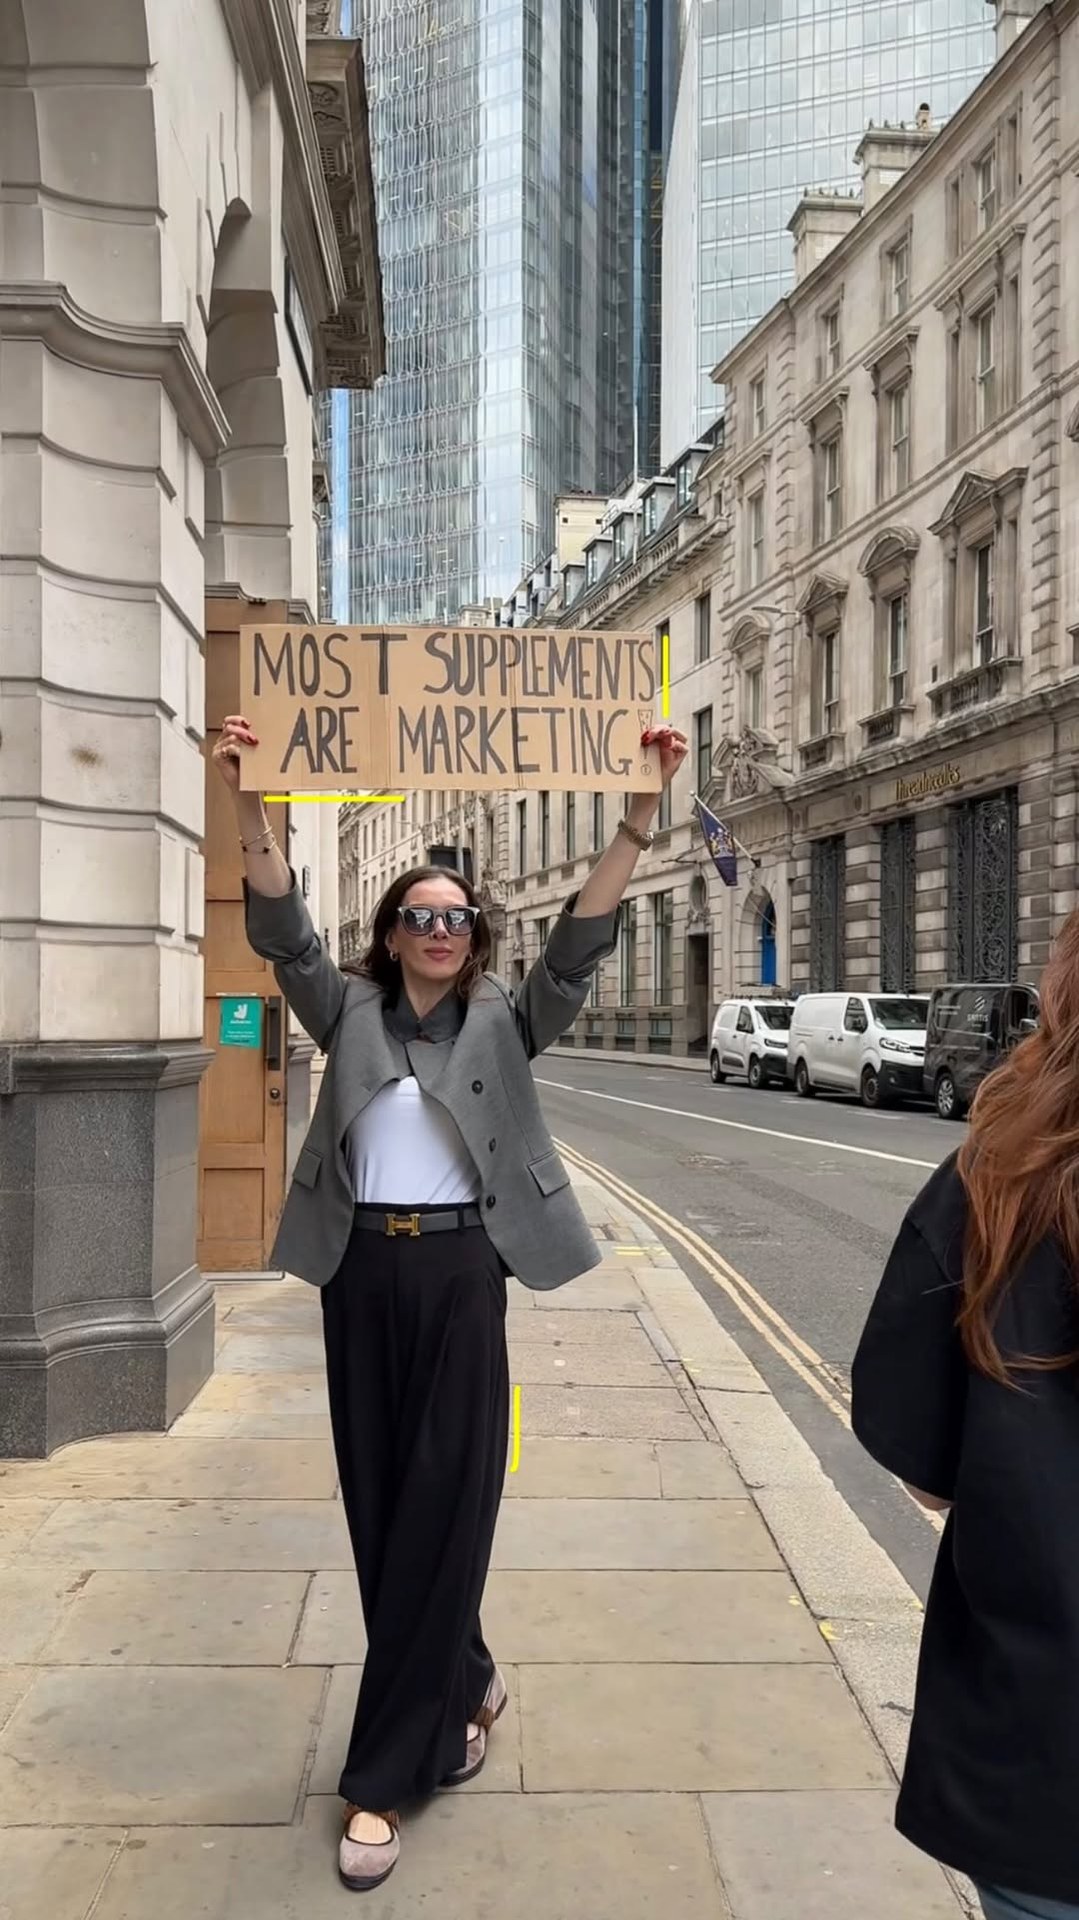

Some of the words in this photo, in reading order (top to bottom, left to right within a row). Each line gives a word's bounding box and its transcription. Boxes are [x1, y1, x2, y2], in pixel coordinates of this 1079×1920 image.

[253, 632, 408, 699] MOST
[423, 631, 655, 703] SUPPLEMENTS
[280, 706, 360, 774] ARE
